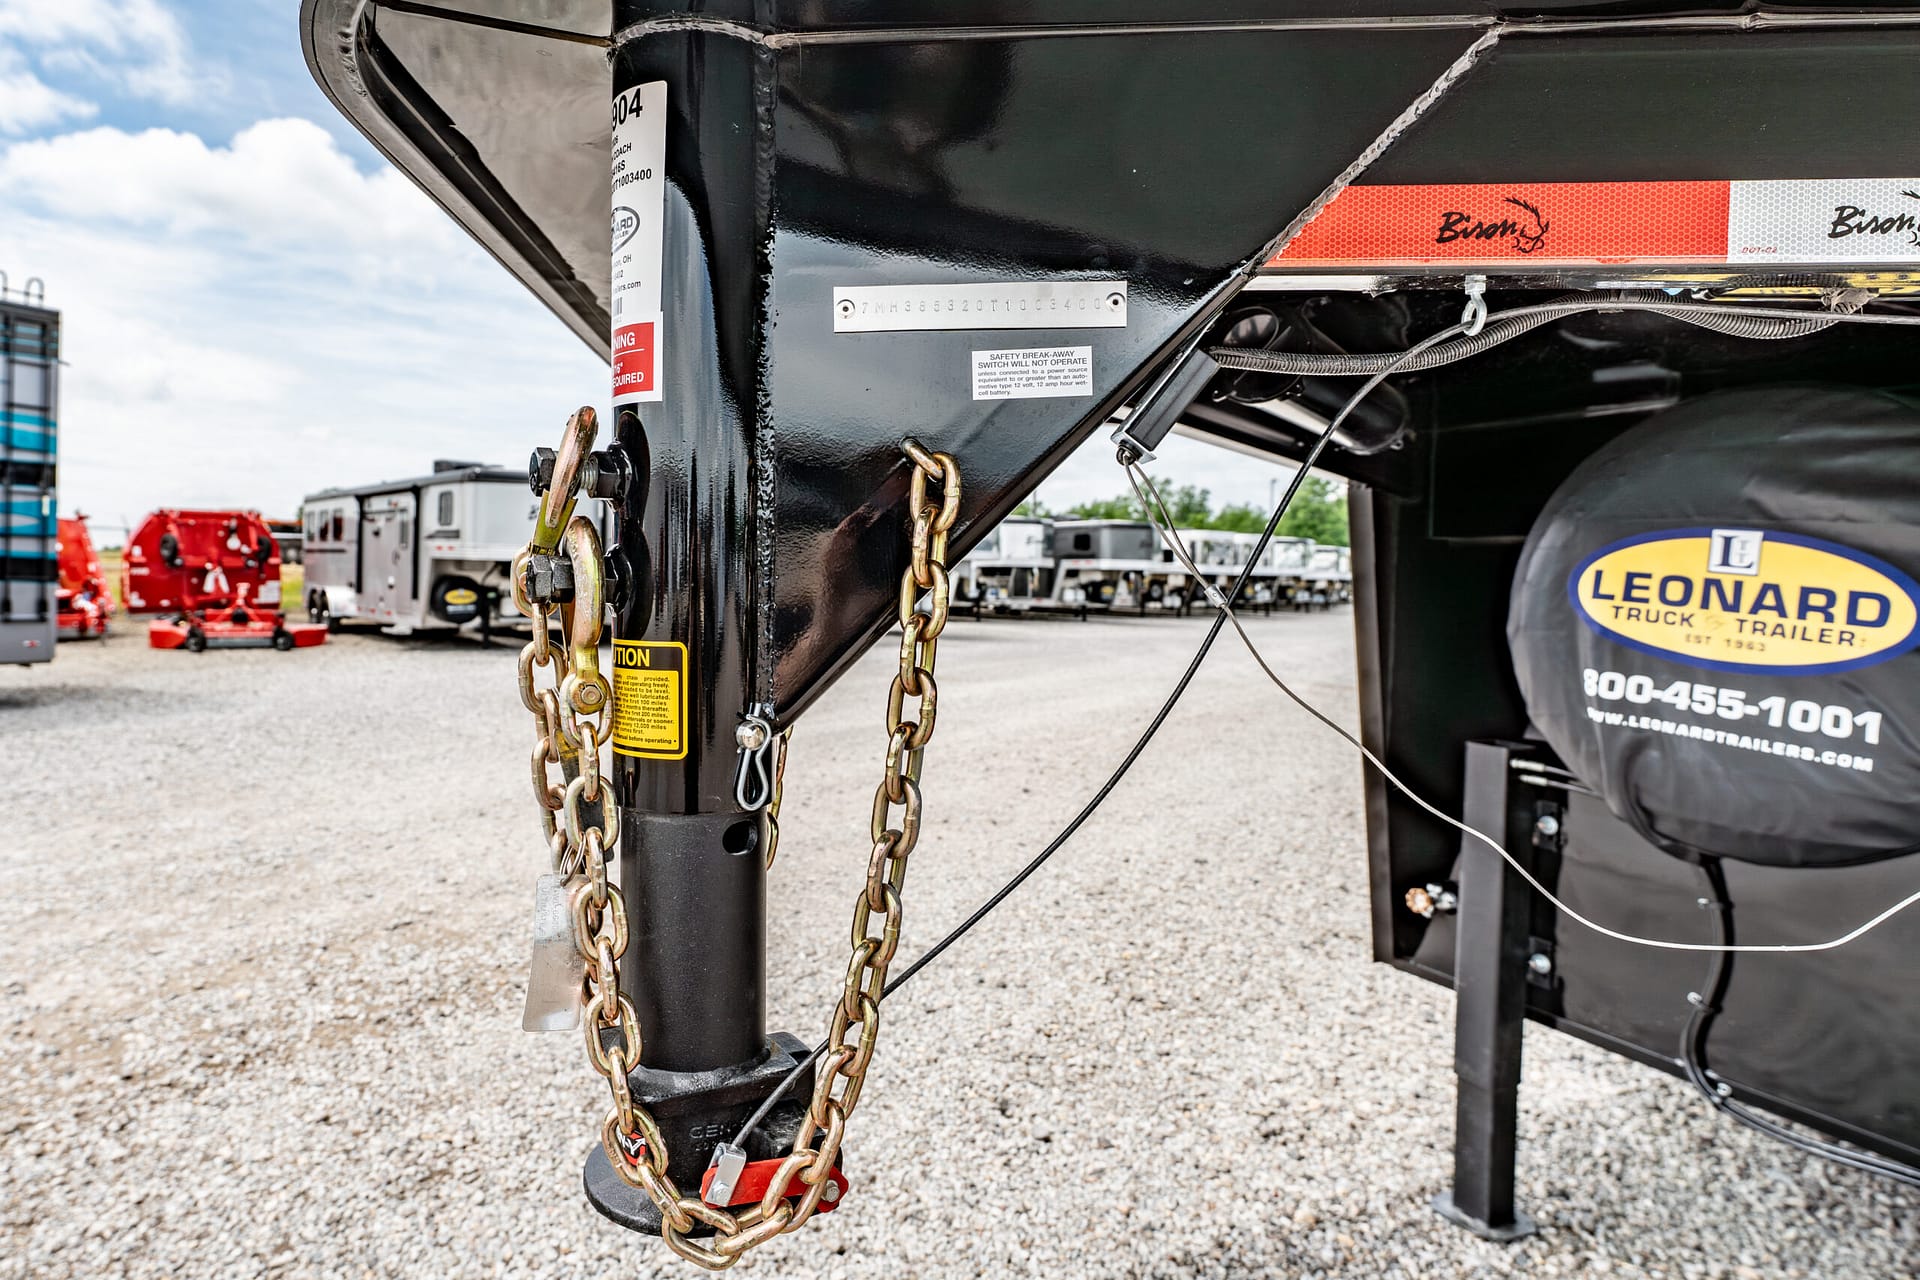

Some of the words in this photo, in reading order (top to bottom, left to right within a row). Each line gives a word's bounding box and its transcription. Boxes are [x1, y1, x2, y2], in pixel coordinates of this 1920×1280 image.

[1435, 211, 1517, 243] Bison
[1830, 205, 1915, 238] Bison
[623, 254, 632, 264] OH
[978, 360, 1009, 369] SWITCH
[1010, 360, 1030, 368] WILL
[1031, 359, 1048, 367] NOT
[1050, 357, 1088, 366] OPERATE
[990, 352, 1021, 361] SAFETY
[1022, 350, 1075, 360] BREAK-AWAY
[978, 376, 1008, 384] equivalent
[1025, 375, 1046, 383] greater
[1592, 569, 1891, 629] LEONARD
[1612, 606, 1695, 628] TRUCK
[1736, 618, 1856, 646] TRAILER
[1685, 634, 1712, 645] EST
[1583, 668, 1882, 745] 800-455-1001
